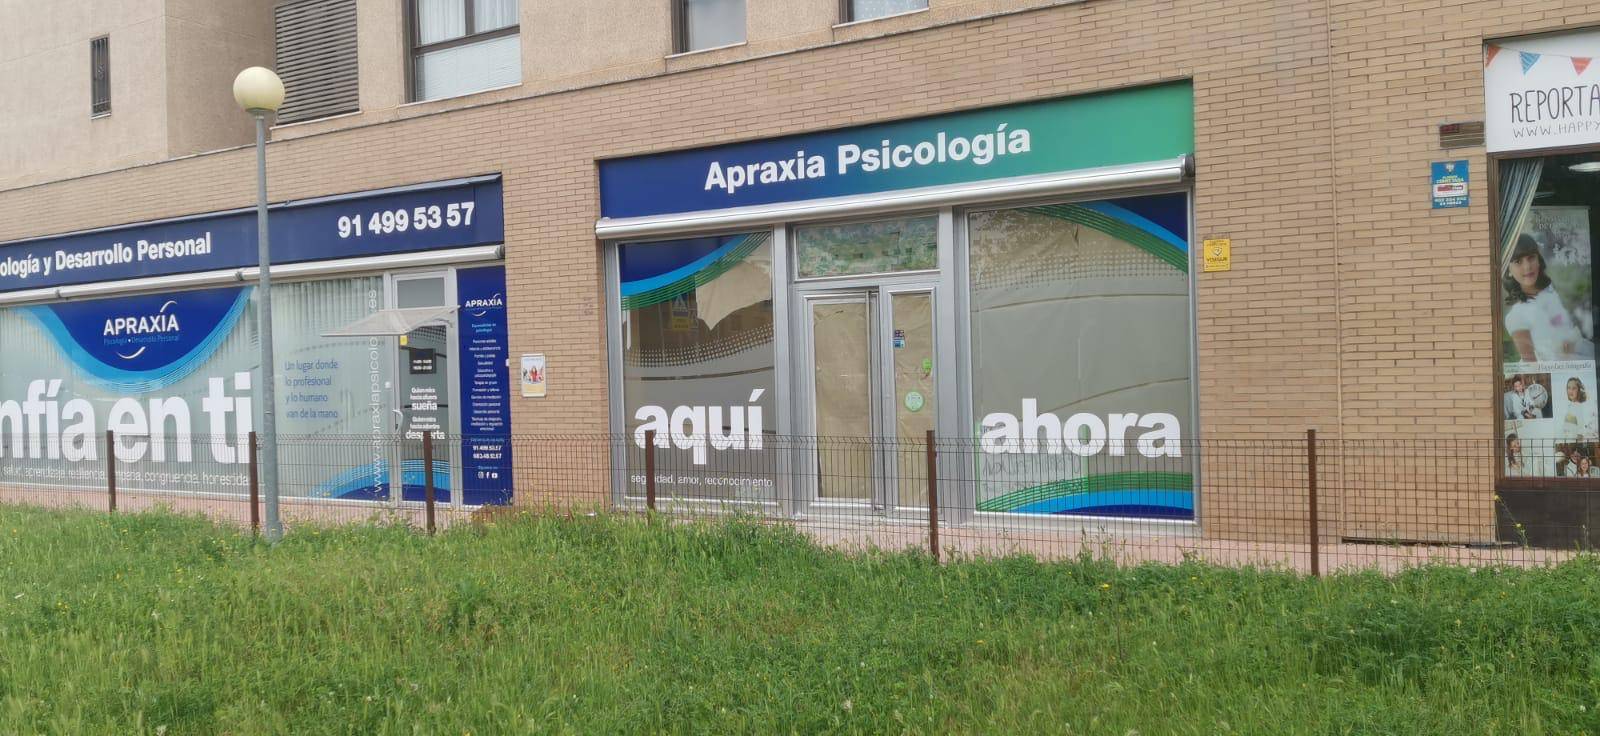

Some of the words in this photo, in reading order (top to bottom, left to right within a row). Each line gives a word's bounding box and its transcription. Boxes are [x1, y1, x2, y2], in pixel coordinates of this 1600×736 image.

[1509, 84, 1600, 123] REPORTA
[704, 150, 826, 194] Apraxia
[837, 122, 1031, 175] Psicología
[337, 213, 362, 239] 91
[368, 208, 409, 235] 499
[413, 205, 442, 231] 53
[446, 201, 475, 227] 57
[0, 253, 40, 279] ología
[43, 256, 52, 276] y
[55, 242, 133, 271] Desarrollo
[137, 231, 212, 262] Personal
[293, 375, 332, 389] profesional
[316, 359, 338, 369] donde
[0, 379, 97, 462] nfía
[108, 397, 192, 463] en
[202, 372, 253, 464] ti
[411, 400, 438, 411] sueña
[634, 388, 765, 465] aquí
[981, 398, 1182, 458] ahora
[631, 474, 676, 486] segidad,
